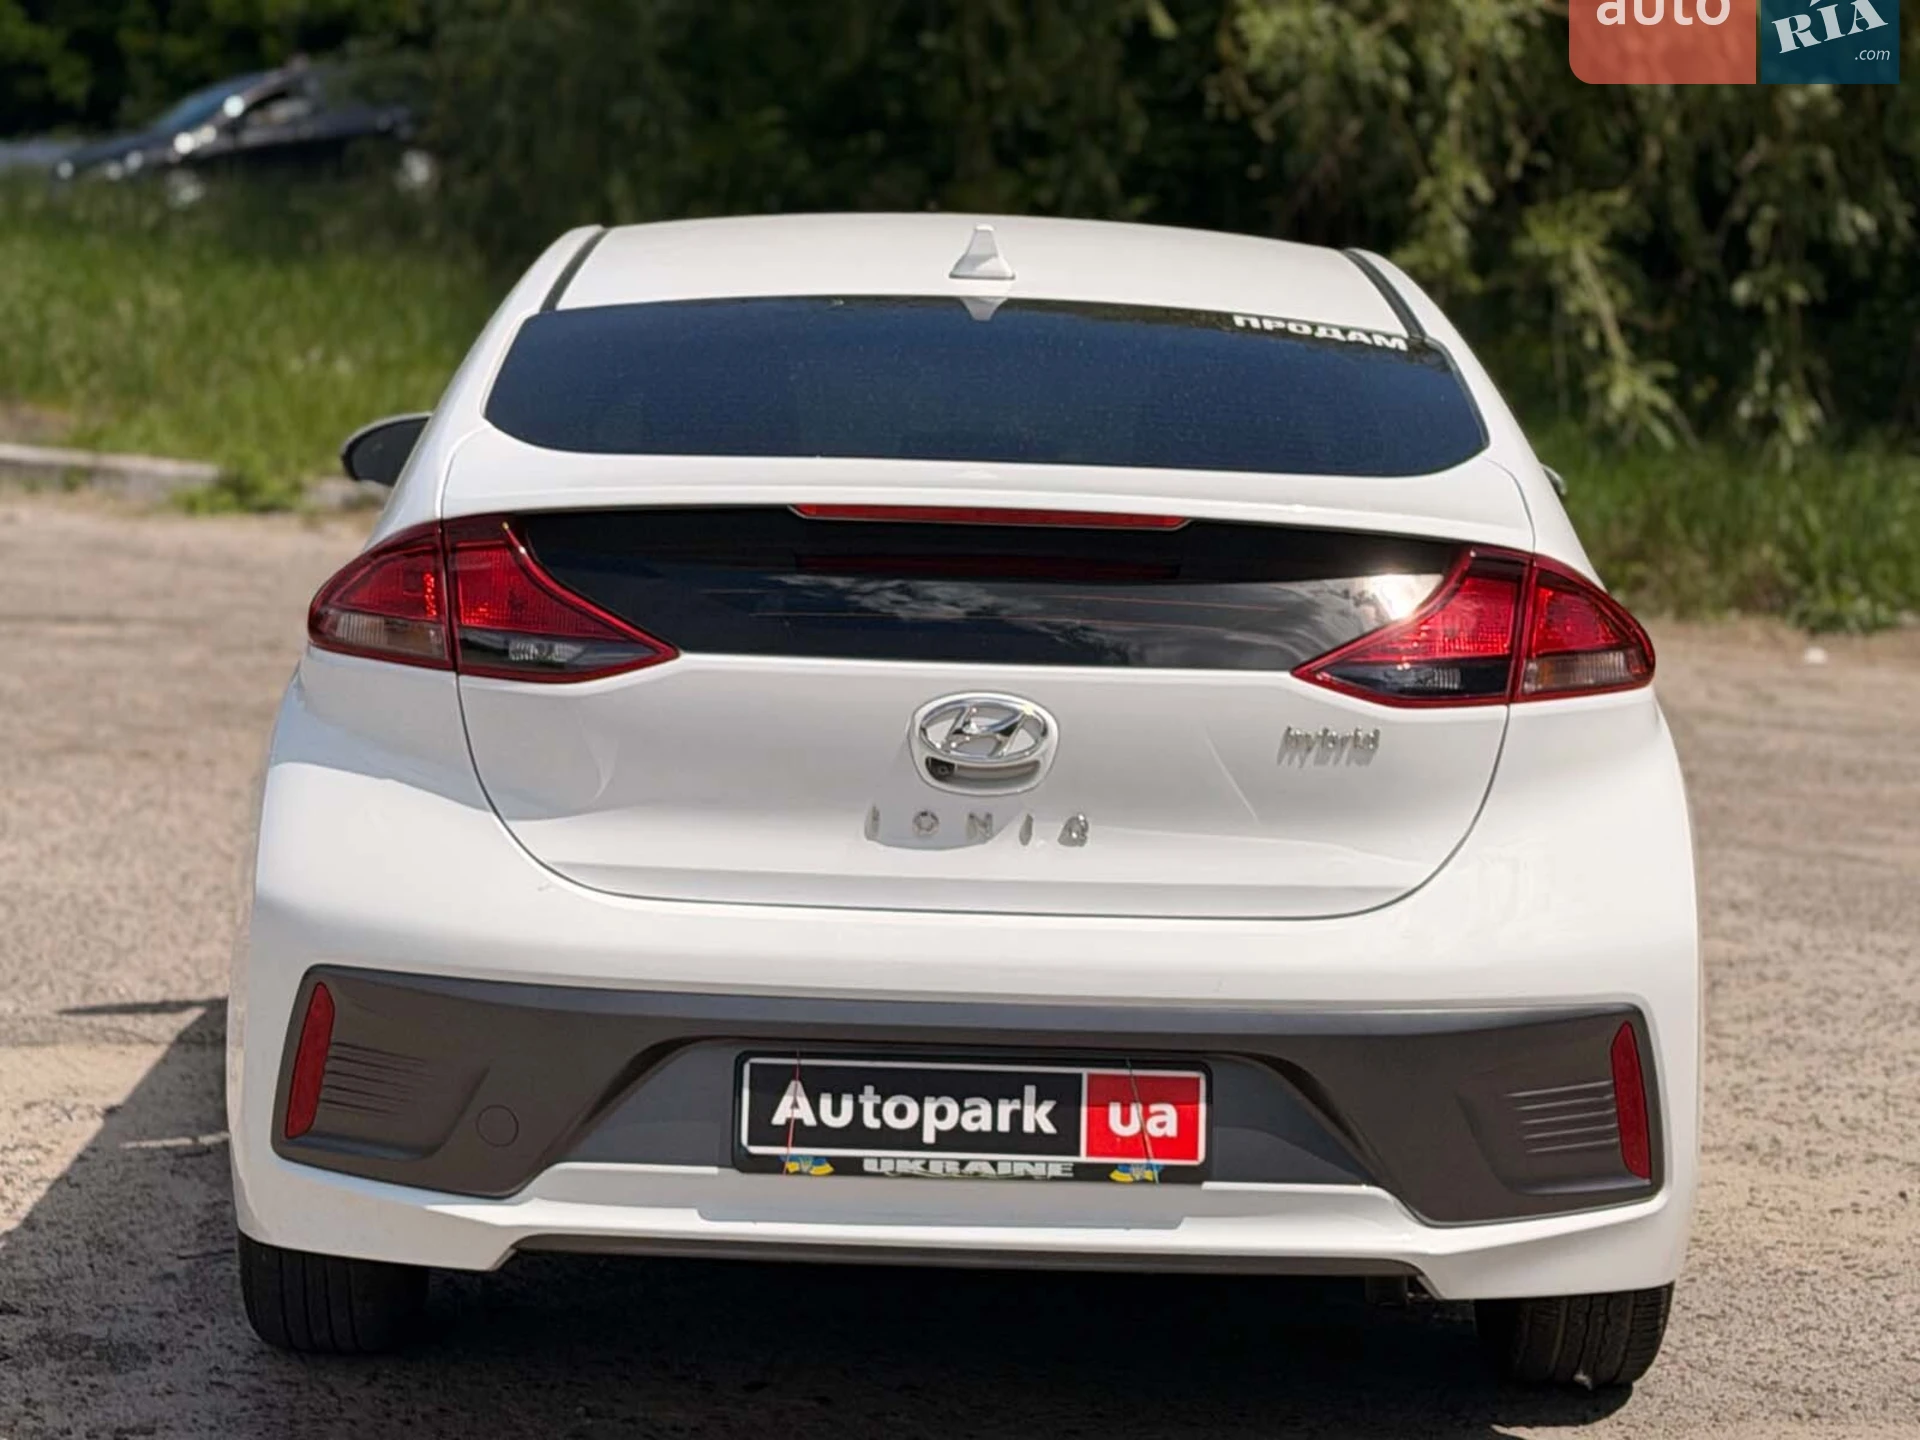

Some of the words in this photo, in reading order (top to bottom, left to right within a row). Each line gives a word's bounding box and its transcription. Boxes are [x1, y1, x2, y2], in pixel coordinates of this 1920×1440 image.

[1232, 314, 1409, 352] ПРОДАМ
[1279, 725, 1381, 759] hybrid
[864, 802, 1089, 848] IONIQ
[771, 1079, 1058, 1144] Autopark
[1106, 1099, 1178, 1139] ua
[863, 1156, 1075, 1179] UKRAINE
